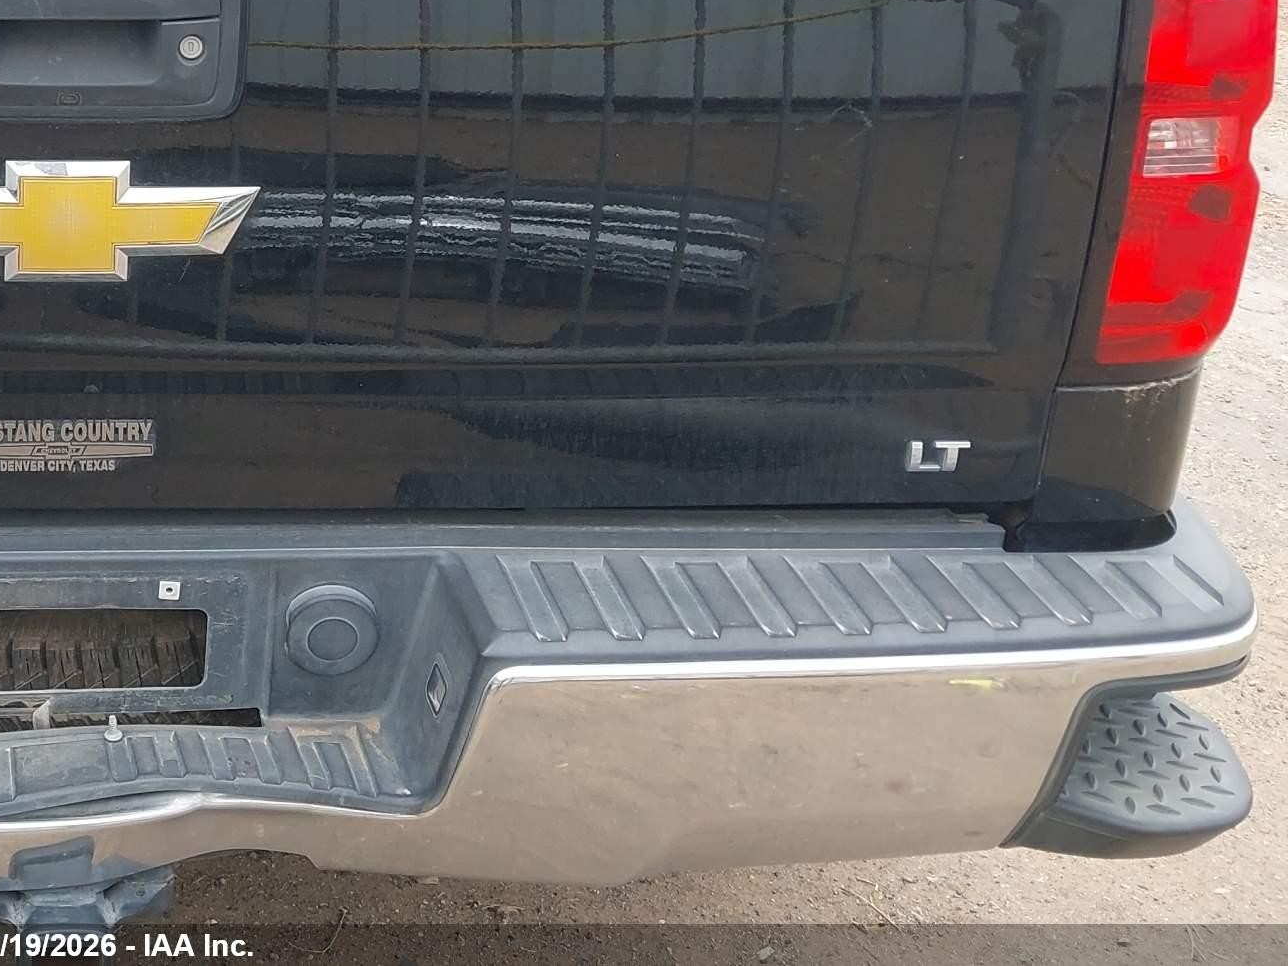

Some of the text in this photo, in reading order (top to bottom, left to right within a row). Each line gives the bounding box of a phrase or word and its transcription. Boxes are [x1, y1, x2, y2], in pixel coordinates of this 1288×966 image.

[60, 420, 152, 441] COUNTRY
[0, 460, 115, 473] DENVER CITY, TEXAS
[905, 440, 971, 472] LT
